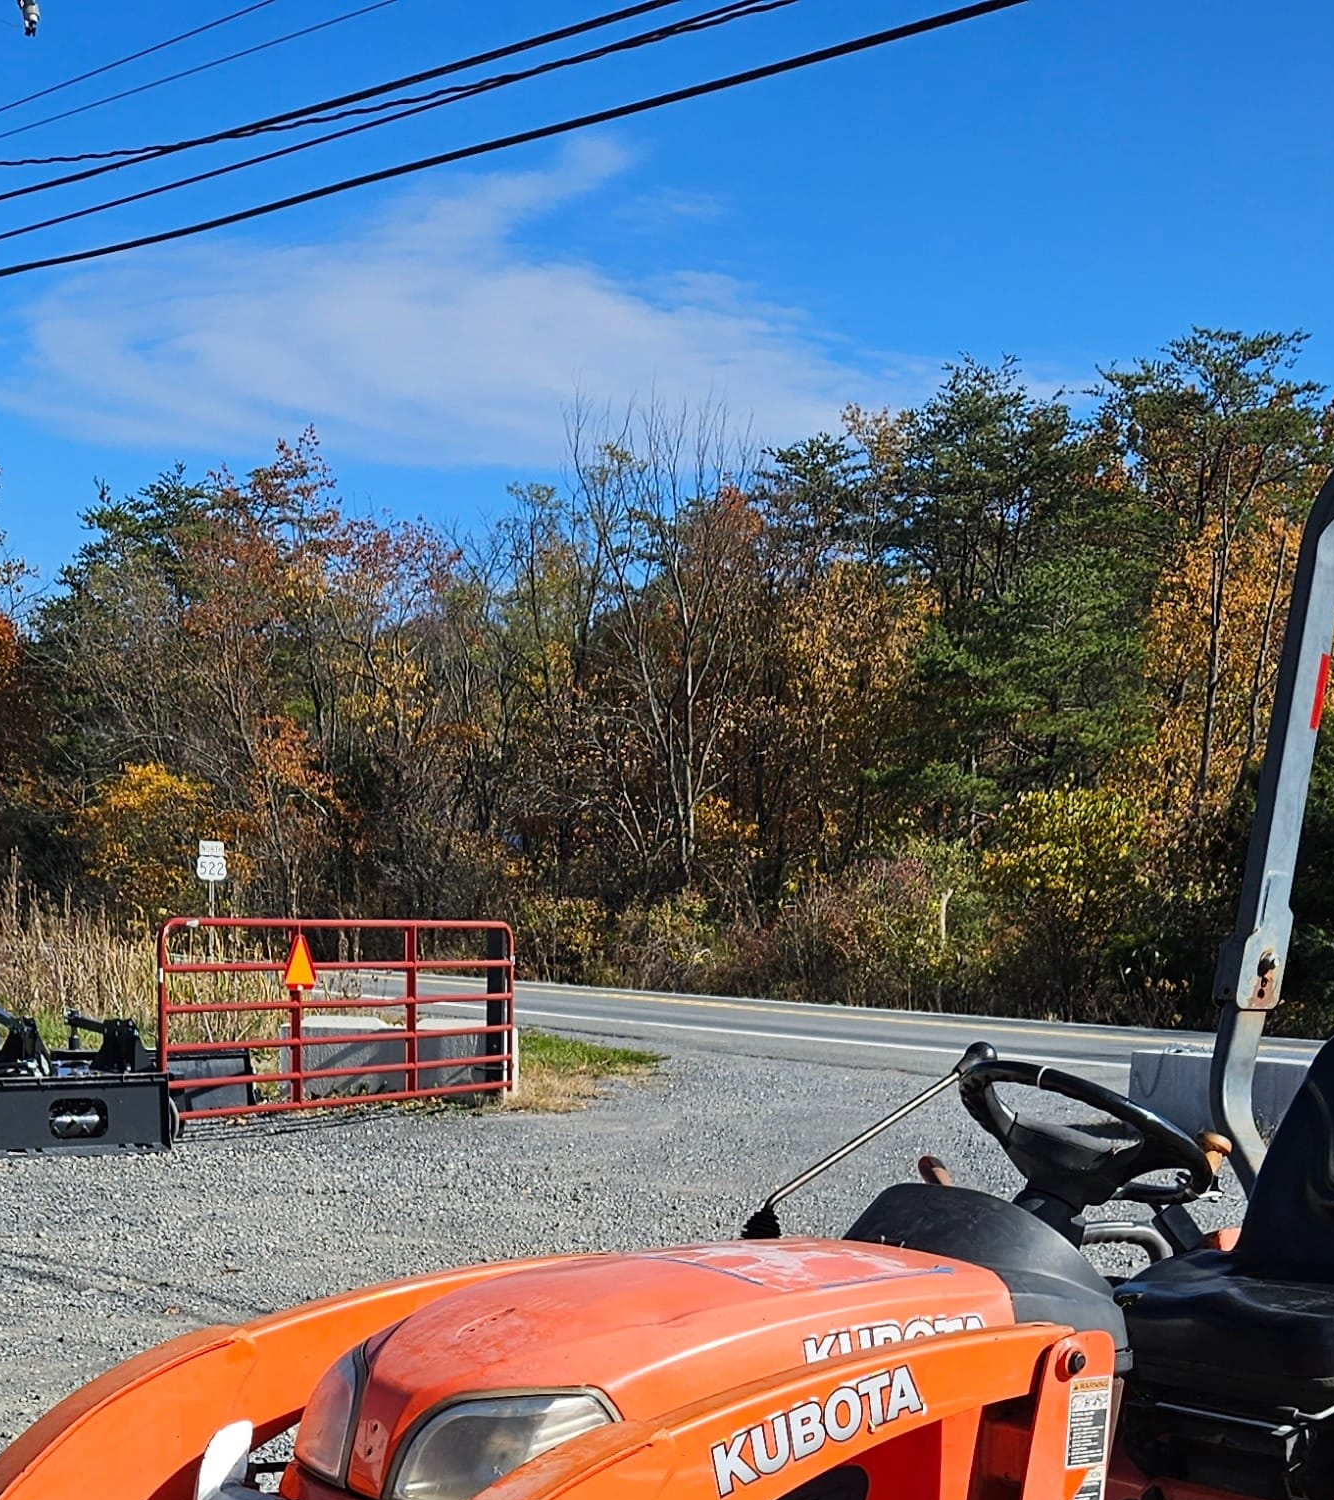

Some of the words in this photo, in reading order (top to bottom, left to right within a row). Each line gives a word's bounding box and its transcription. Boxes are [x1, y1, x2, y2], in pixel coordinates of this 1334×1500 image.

[199, 861, 225, 876] 522
[1079, 1382, 1109, 1390] WARNING
[710, 1364, 924, 1498] KUBOTA
